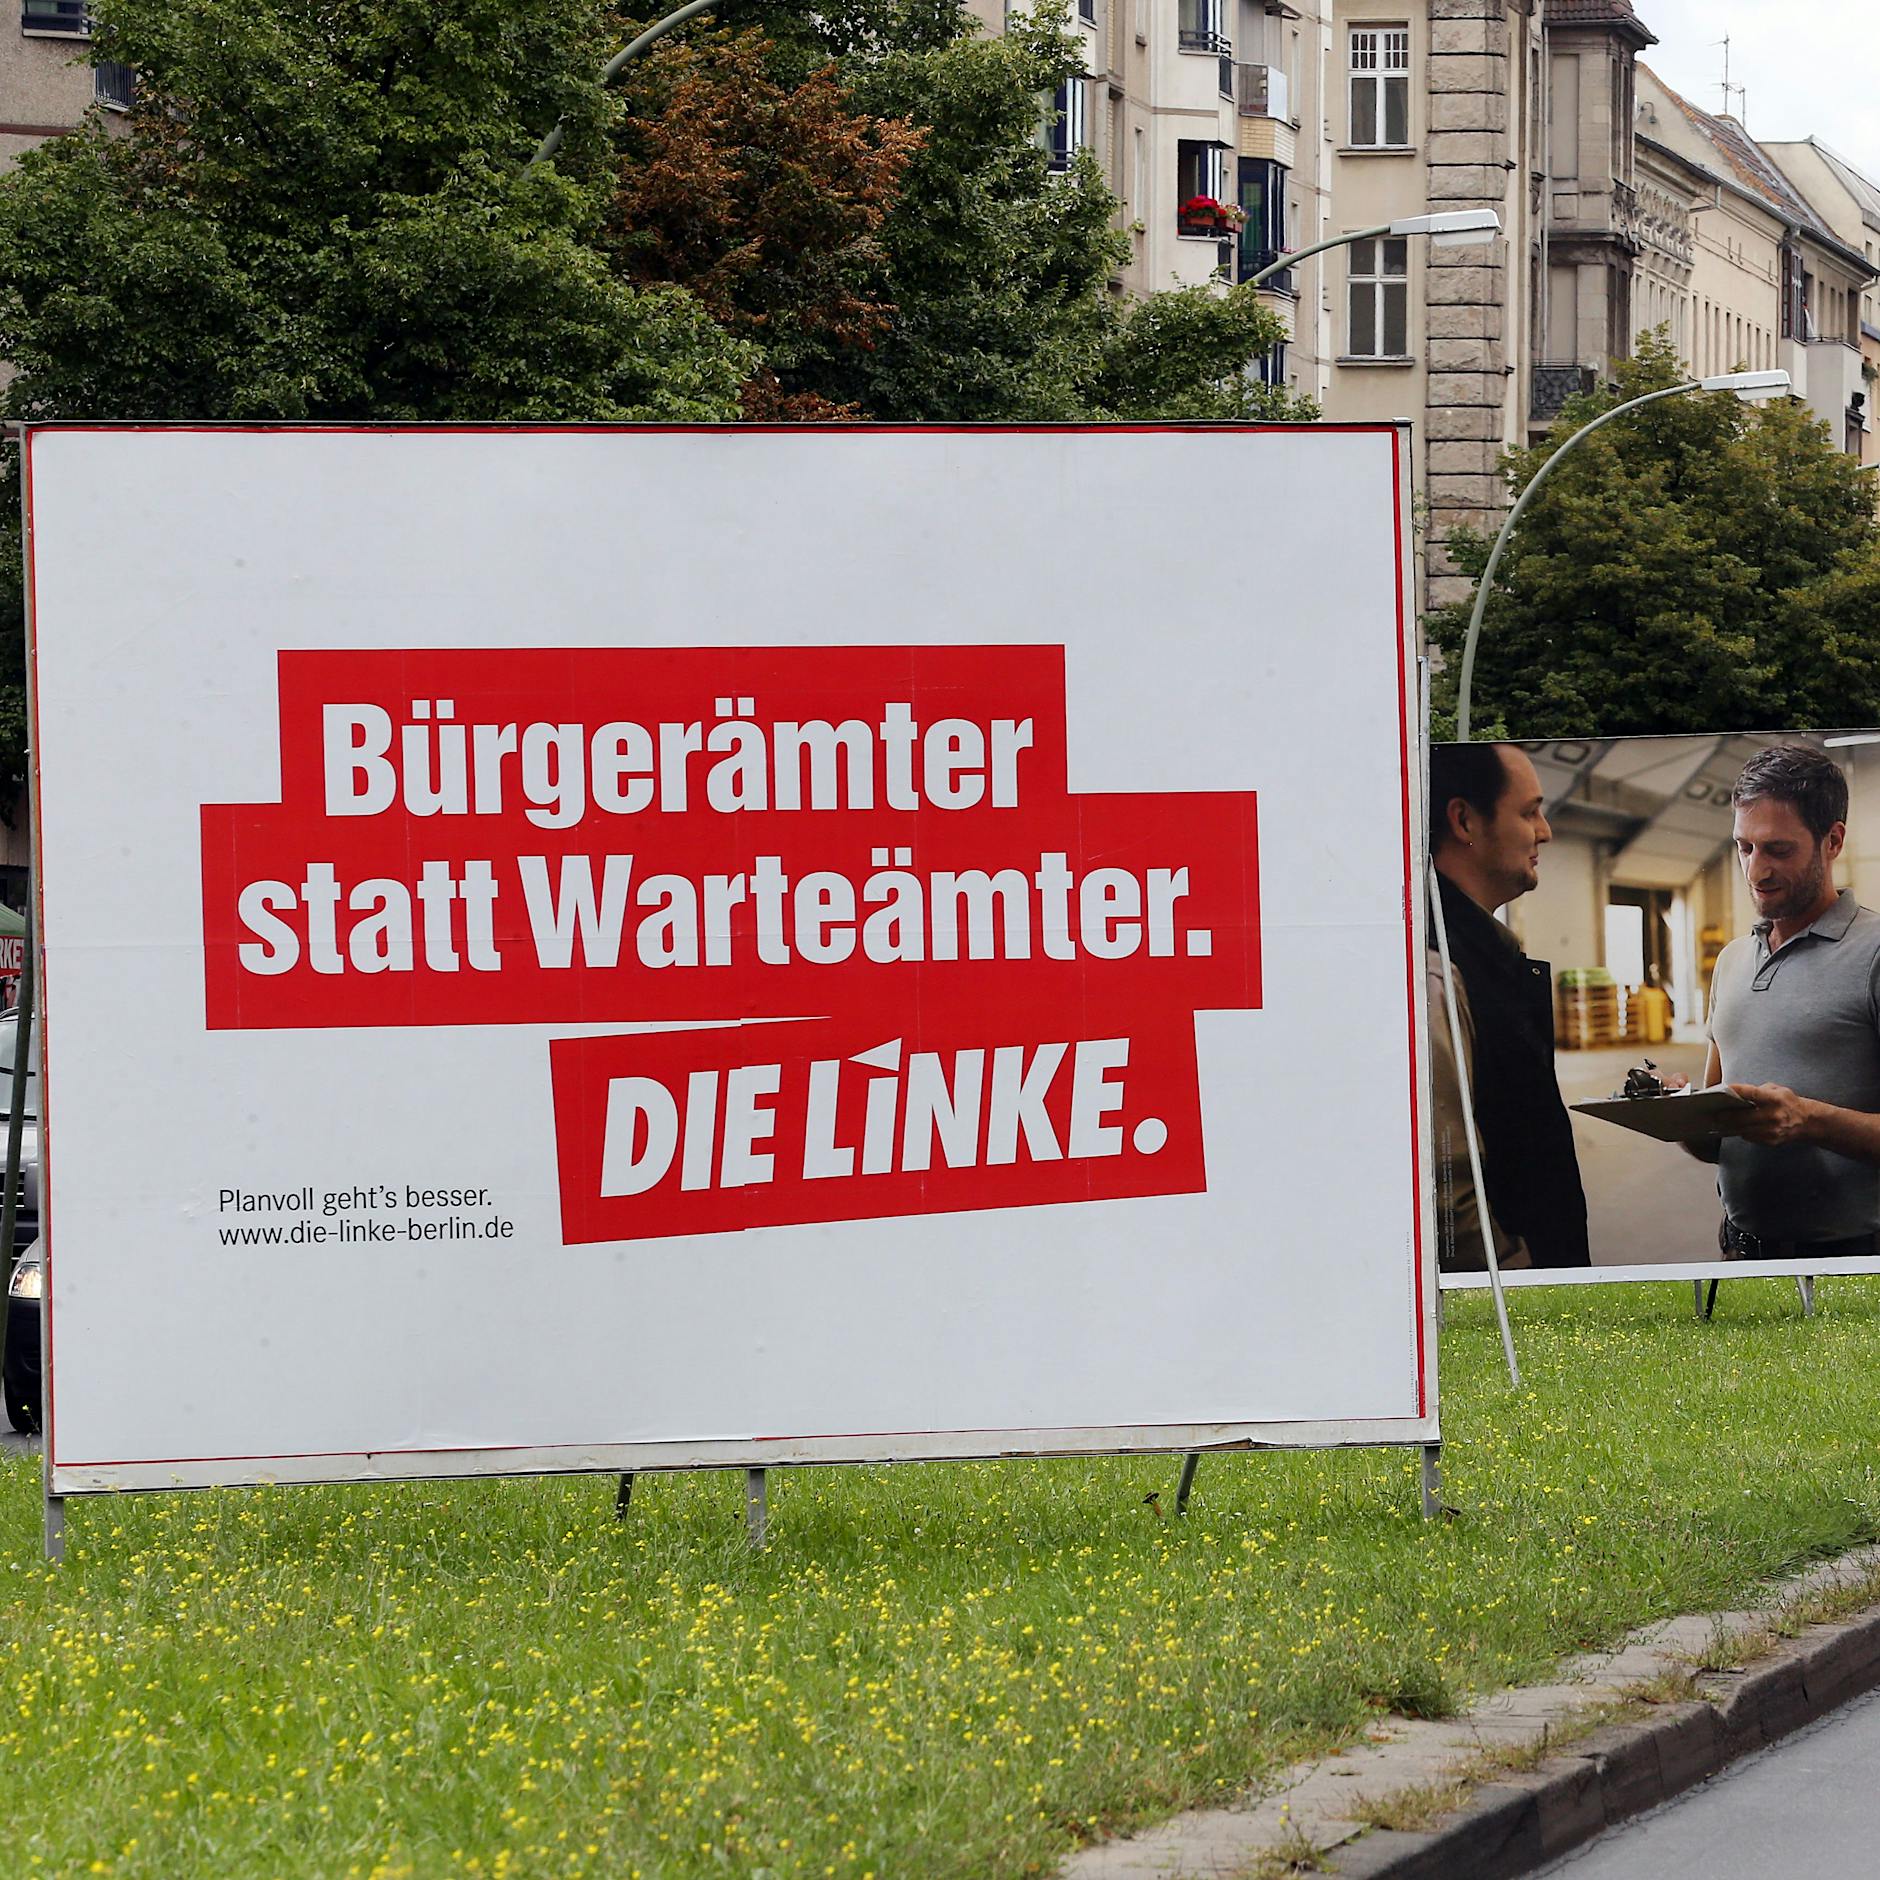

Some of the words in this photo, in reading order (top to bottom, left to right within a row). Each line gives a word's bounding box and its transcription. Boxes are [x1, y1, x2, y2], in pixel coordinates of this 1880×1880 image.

[323, 698, 1033, 829] Bürgerämter
[238, 861, 501, 975] statt
[517, 848, 1211, 968] Warteämter.
[601, 1064, 782, 1198] DIE
[219, 1187, 314, 1212] Planvoll
[322, 1185, 398, 1216] geht’s
[406, 1185, 492, 1208] besser.
[219, 1215, 514, 1246] www.die-linke-berlin.de
